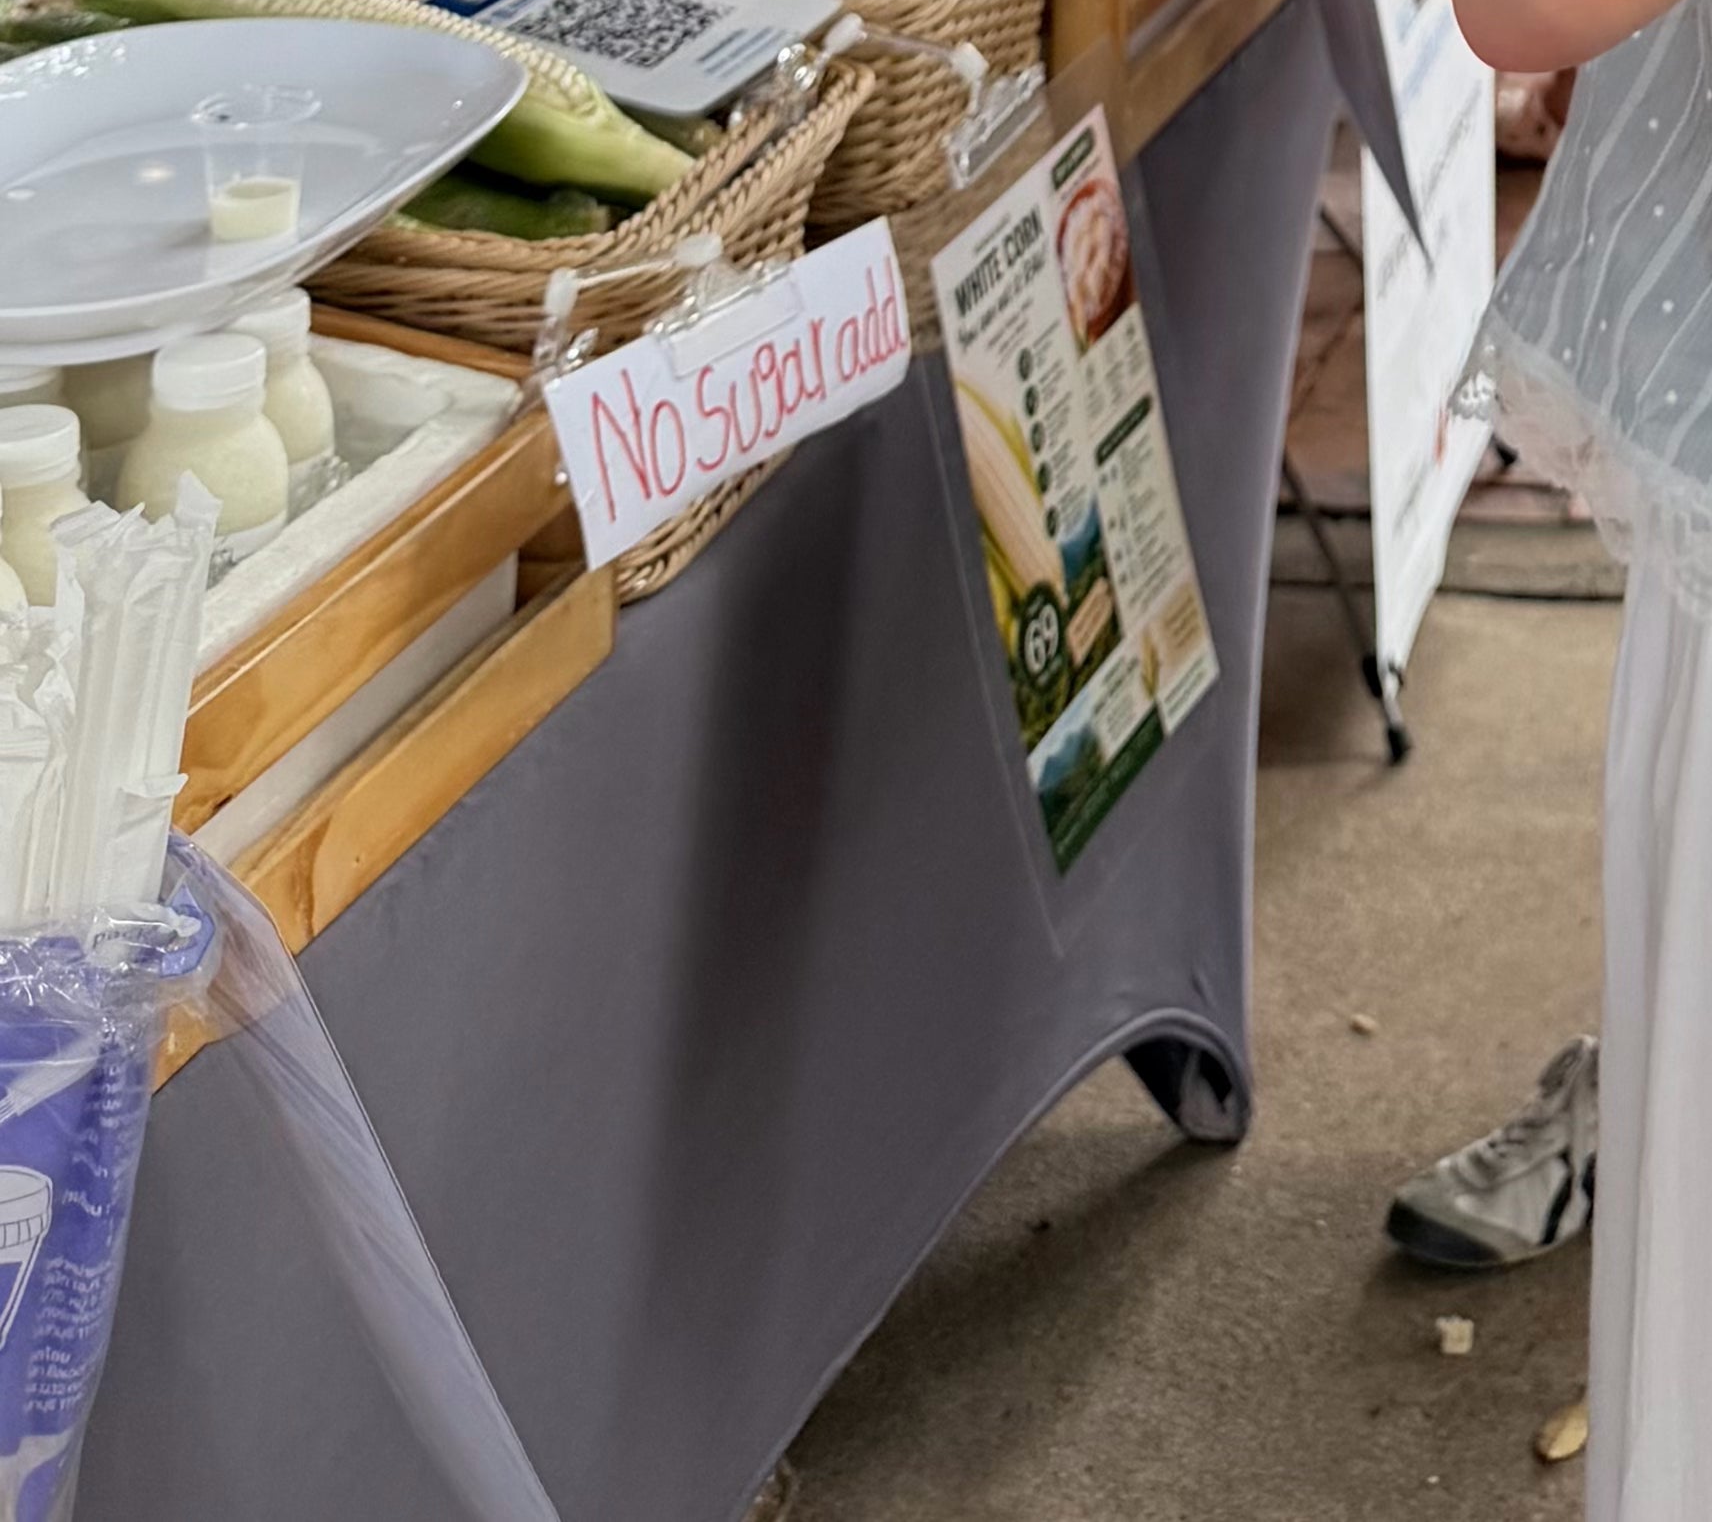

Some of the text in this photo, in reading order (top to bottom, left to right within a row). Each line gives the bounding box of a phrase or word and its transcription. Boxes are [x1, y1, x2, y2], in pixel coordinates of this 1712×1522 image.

[954, 245, 1003, 318] WHITE
[1003, 205, 1044, 268] CORN
[591, 368, 687, 524] No
[836, 257, 908, 383] add
[1024, 604, 1060, 675] 69
